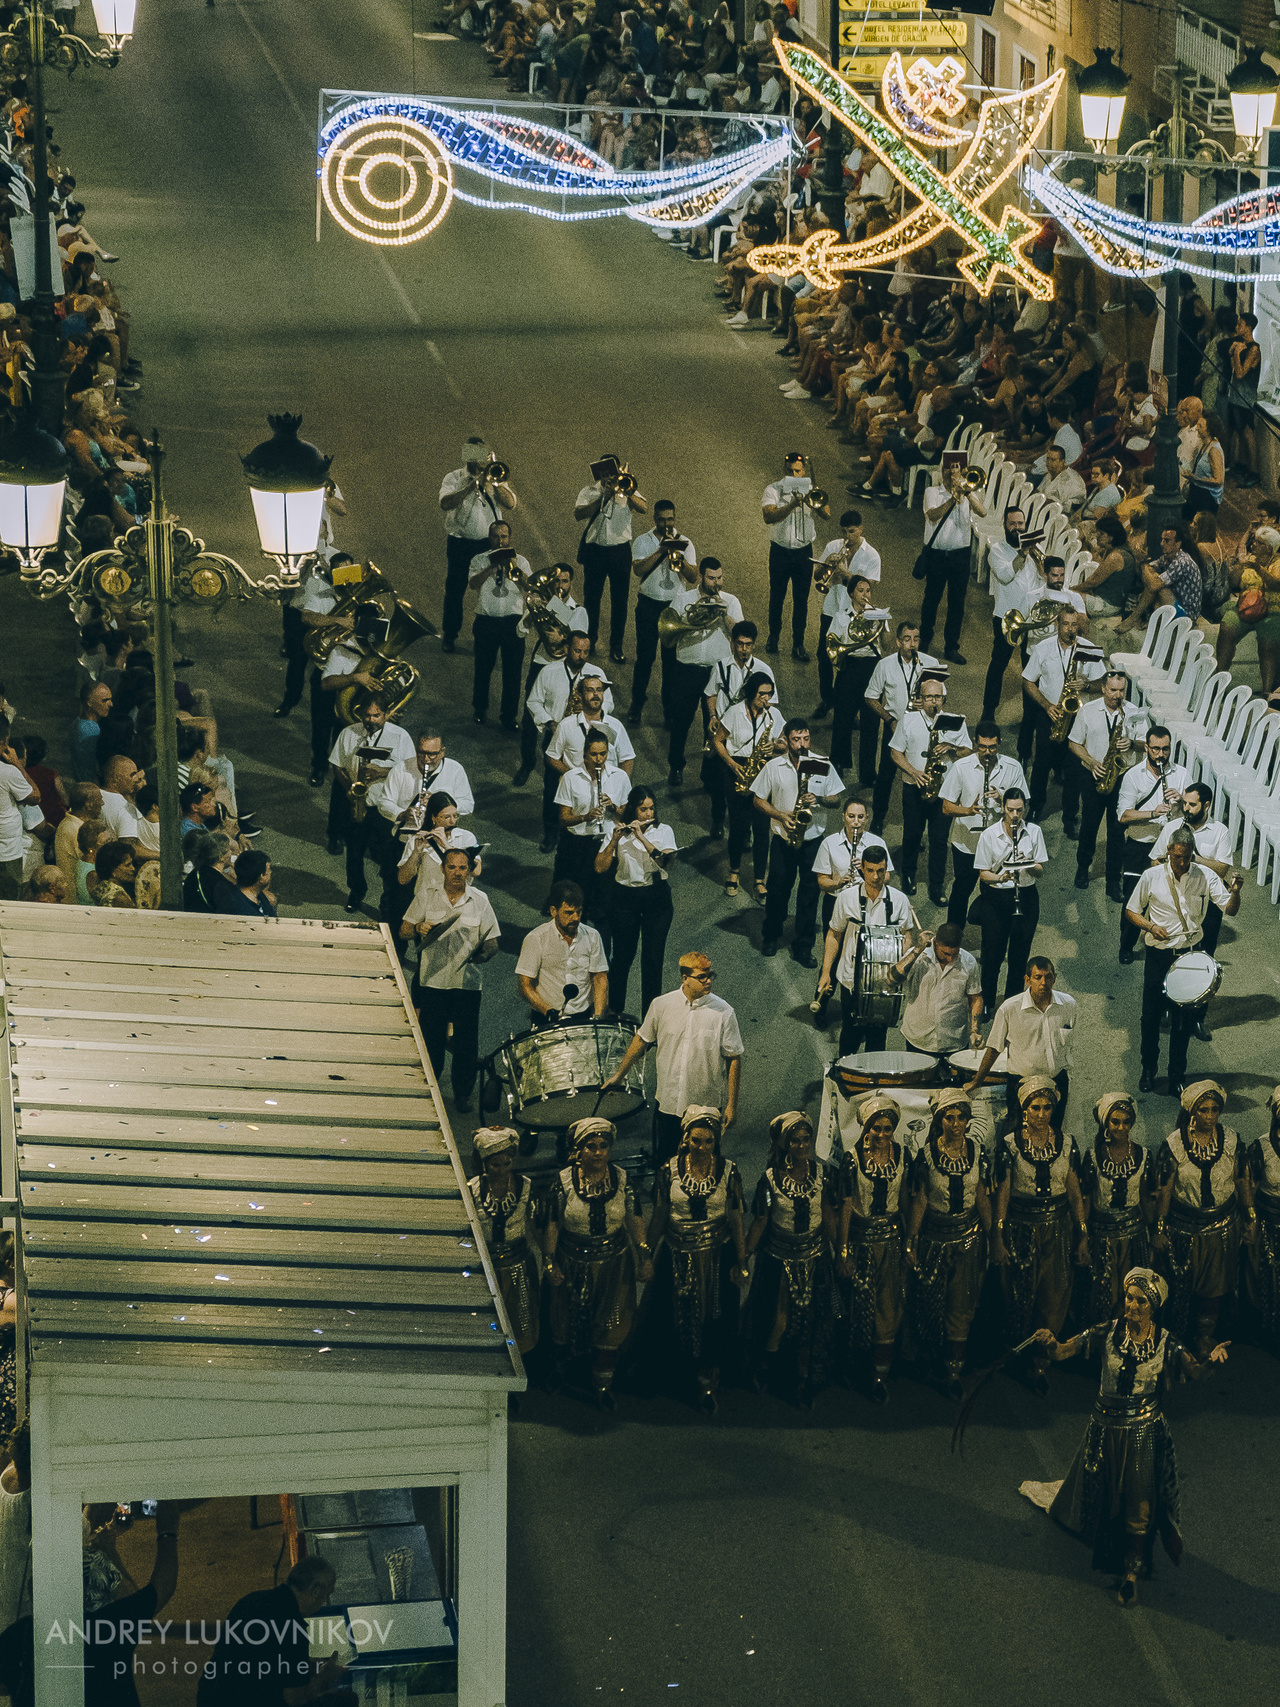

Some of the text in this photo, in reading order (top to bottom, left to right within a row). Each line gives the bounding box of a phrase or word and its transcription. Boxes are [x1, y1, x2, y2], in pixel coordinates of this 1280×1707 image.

[865, 0, 918, 8] HOTEL LEVANTE
[864, 24, 885, 33] HOTEL
[888, 24, 928, 33] RESIDENCIA
[864, 34, 928, 42] VIRGEN DE GRACIA
